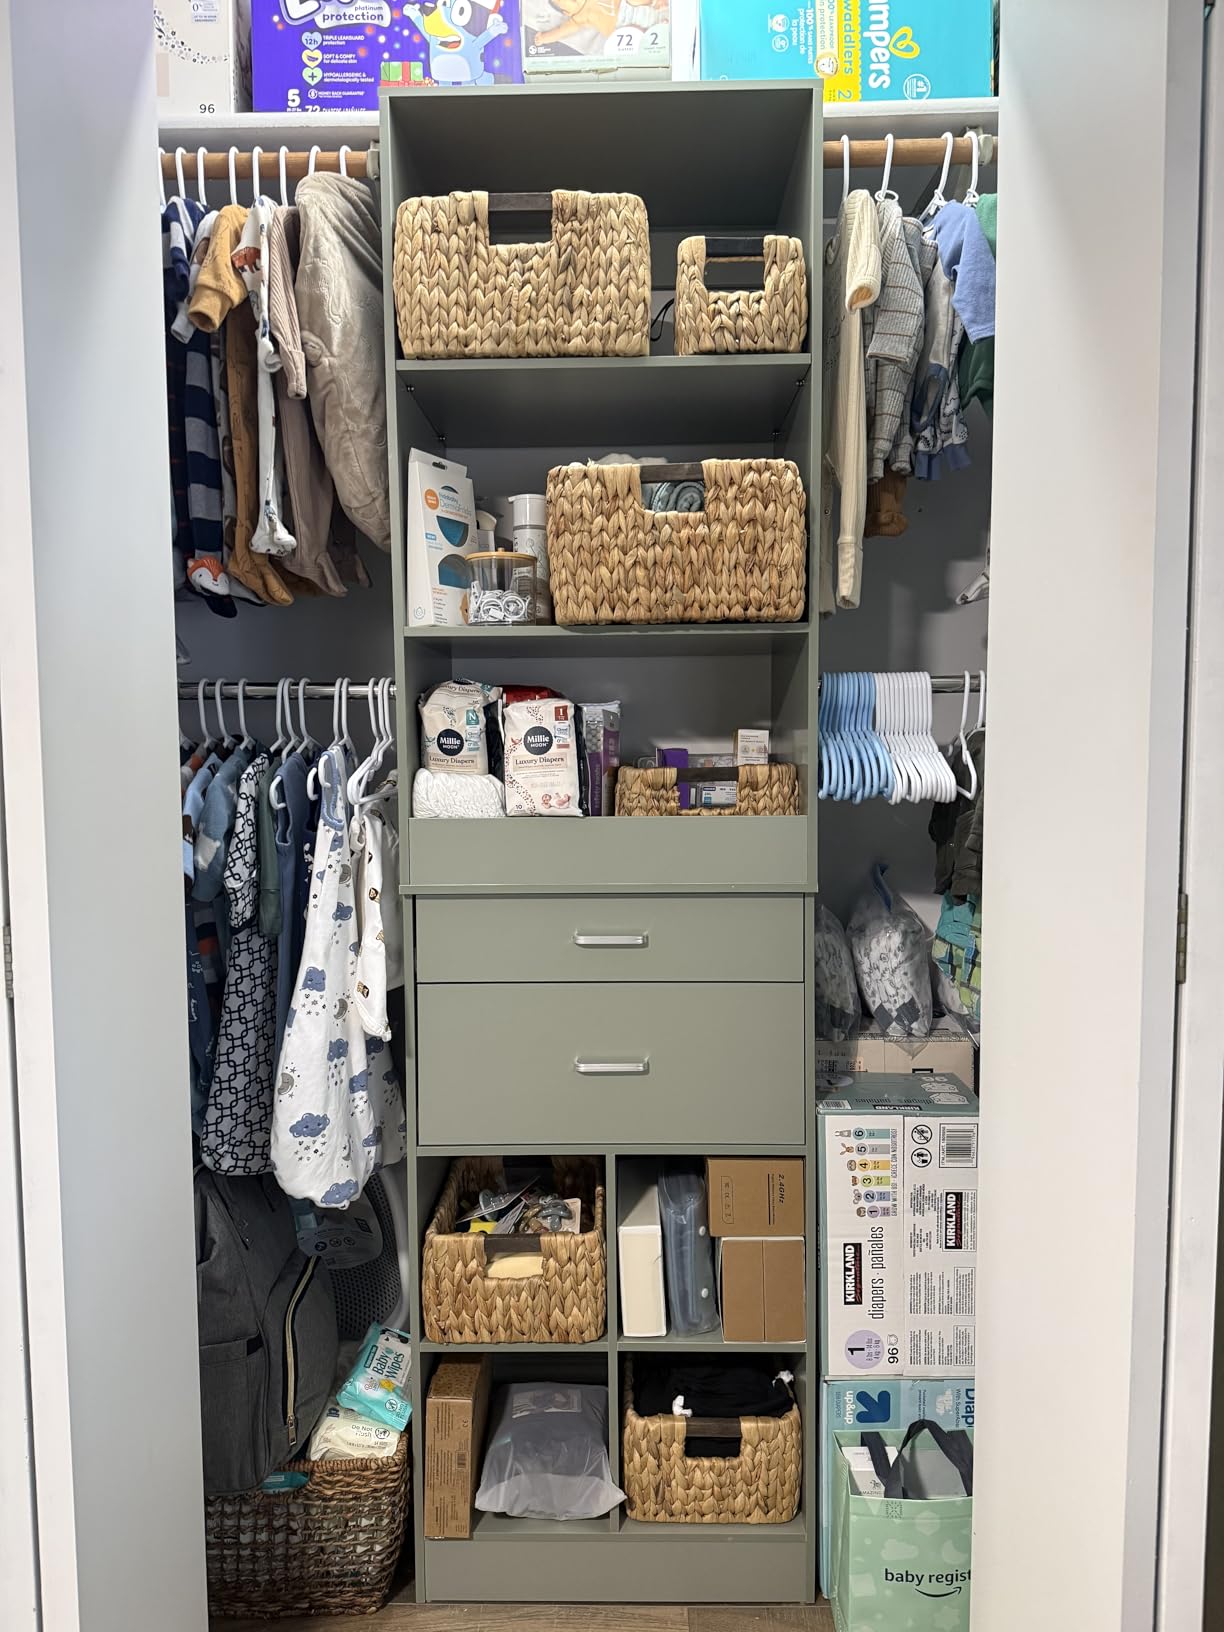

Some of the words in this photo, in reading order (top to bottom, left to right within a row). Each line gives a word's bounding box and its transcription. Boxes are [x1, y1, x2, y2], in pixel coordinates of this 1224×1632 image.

[322, 12, 384, 22] protection
[818, 8, 826, 50] protection
[616, 34, 633, 47] 72
[650, 32, 659, 45] 2
[287, 88, 301, 107] 5
[838, 89, 852, 100] 2
[199, 103, 215, 114] 96
[468, 712, 476, 720] N
[559, 708, 564, 716] 1
[440, 737, 461, 745] Millie
[527, 734, 550, 743] Millie
[429, 755, 450, 764] Luxury
[515, 758, 538, 766] Luxury
[539, 756, 564, 764] Diapers
[859, 1161, 869, 1169] 4
[865, 1192, 875, 1200] 2
[946, 1193, 956, 1247] KIRKLAND
[867, 1226, 886, 1269] pañales
[845, 1245, 855, 1302] KIRKLAND
[867, 1278, 887, 1320] diapers
[847, 1347, 865, 1356] 1
[887, 1347, 899, 1364] 96
[372, 1351, 391, 1376] Baby
[385, 1352, 405, 1379] Wipes
[843, 1390, 856, 1424] up&up
[884, 1568, 924, 1586] baby
